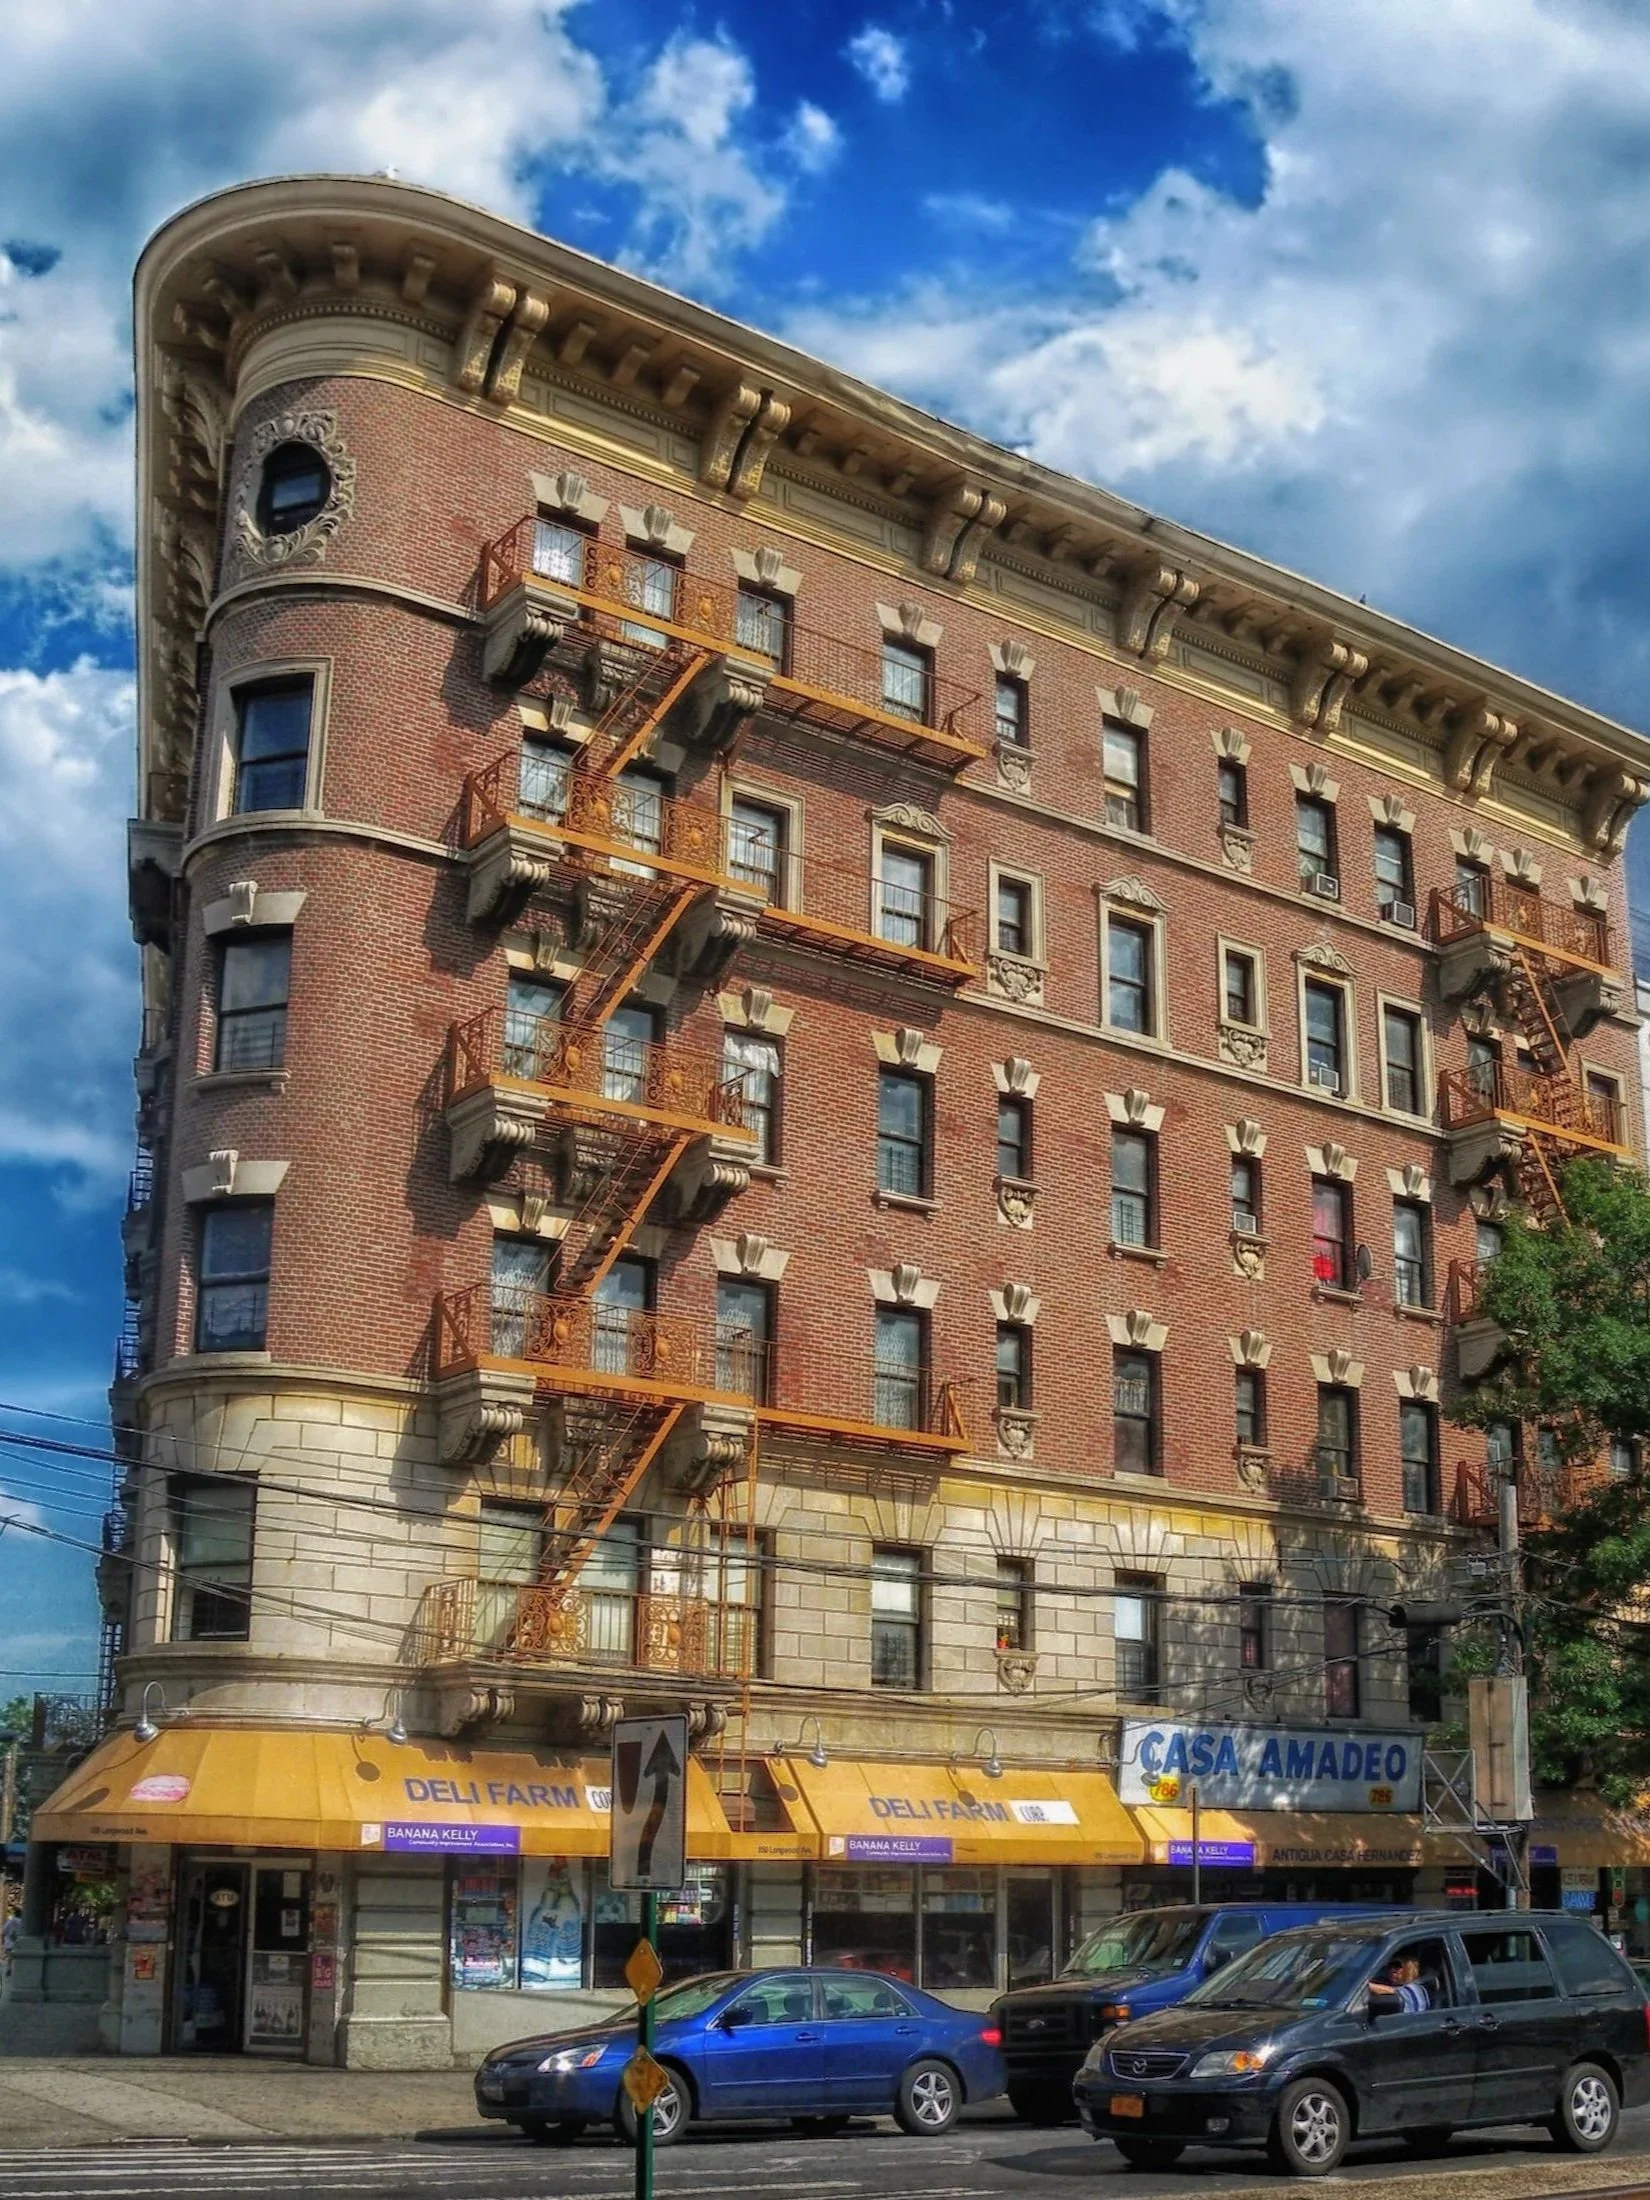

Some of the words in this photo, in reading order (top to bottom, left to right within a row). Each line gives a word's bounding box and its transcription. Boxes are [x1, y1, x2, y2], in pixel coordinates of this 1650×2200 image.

[1140, 1731, 1239, 1777] CASA
[1258, 1738, 1407, 1782] AMADEO
[404, 1778, 481, 1804] DELI
[485, 1782, 580, 1808] FARM
[1154, 1781, 1179, 1798] 786
[869, 1796, 933, 1820] DELI
[934, 1799, 1010, 1822] FARM
[387, 1827, 439, 1840] BANANA
[442, 1829, 479, 1841] KELLY
[849, 1840, 890, 1850] BANANA
[892, 1841, 920, 1851] KELLY
[1170, 1844, 1203, 1855] BANAA
[1204, 1845, 1228, 1856] KELLY
[1272, 1848, 1321, 1861] ANTIGUA
[1325, 1849, 1353, 1861] CASA
